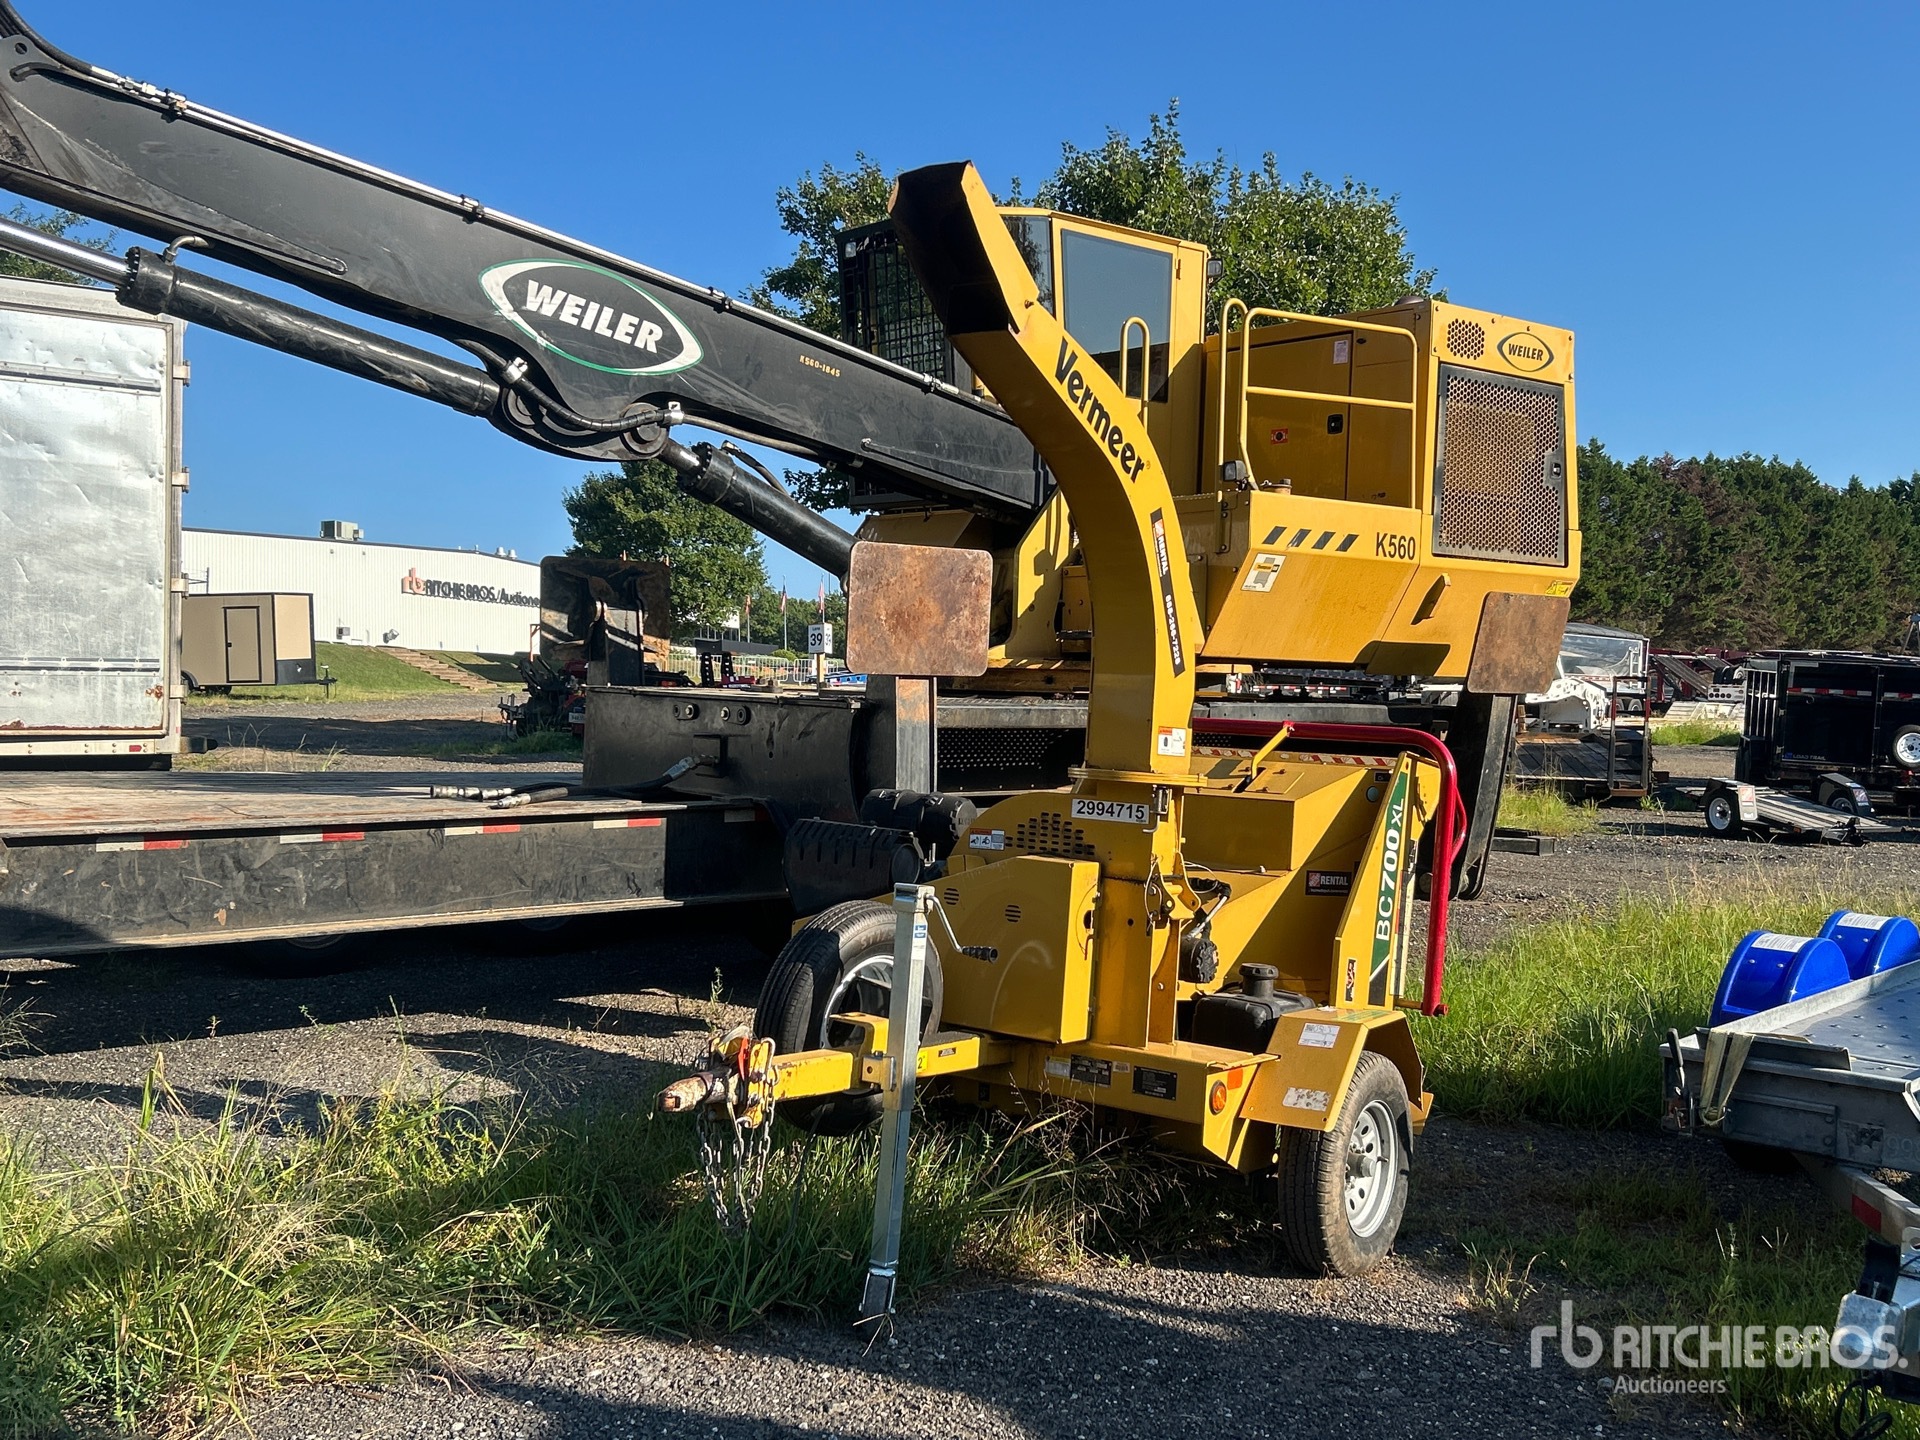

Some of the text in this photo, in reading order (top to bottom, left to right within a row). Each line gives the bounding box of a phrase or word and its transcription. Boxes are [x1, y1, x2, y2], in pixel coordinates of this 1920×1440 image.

[526, 279, 664, 354] WEILER
[1508, 343, 1544, 361] WEILER
[799, 354, 841, 378] K560-1845
[1054, 336, 1146, 484] Vermeer
[1375, 531, 1416, 560] K560
[810, 632, 822, 646] 39
[1076, 800, 1145, 820] 2994715
[1320, 875, 1349, 886] RENTAL
